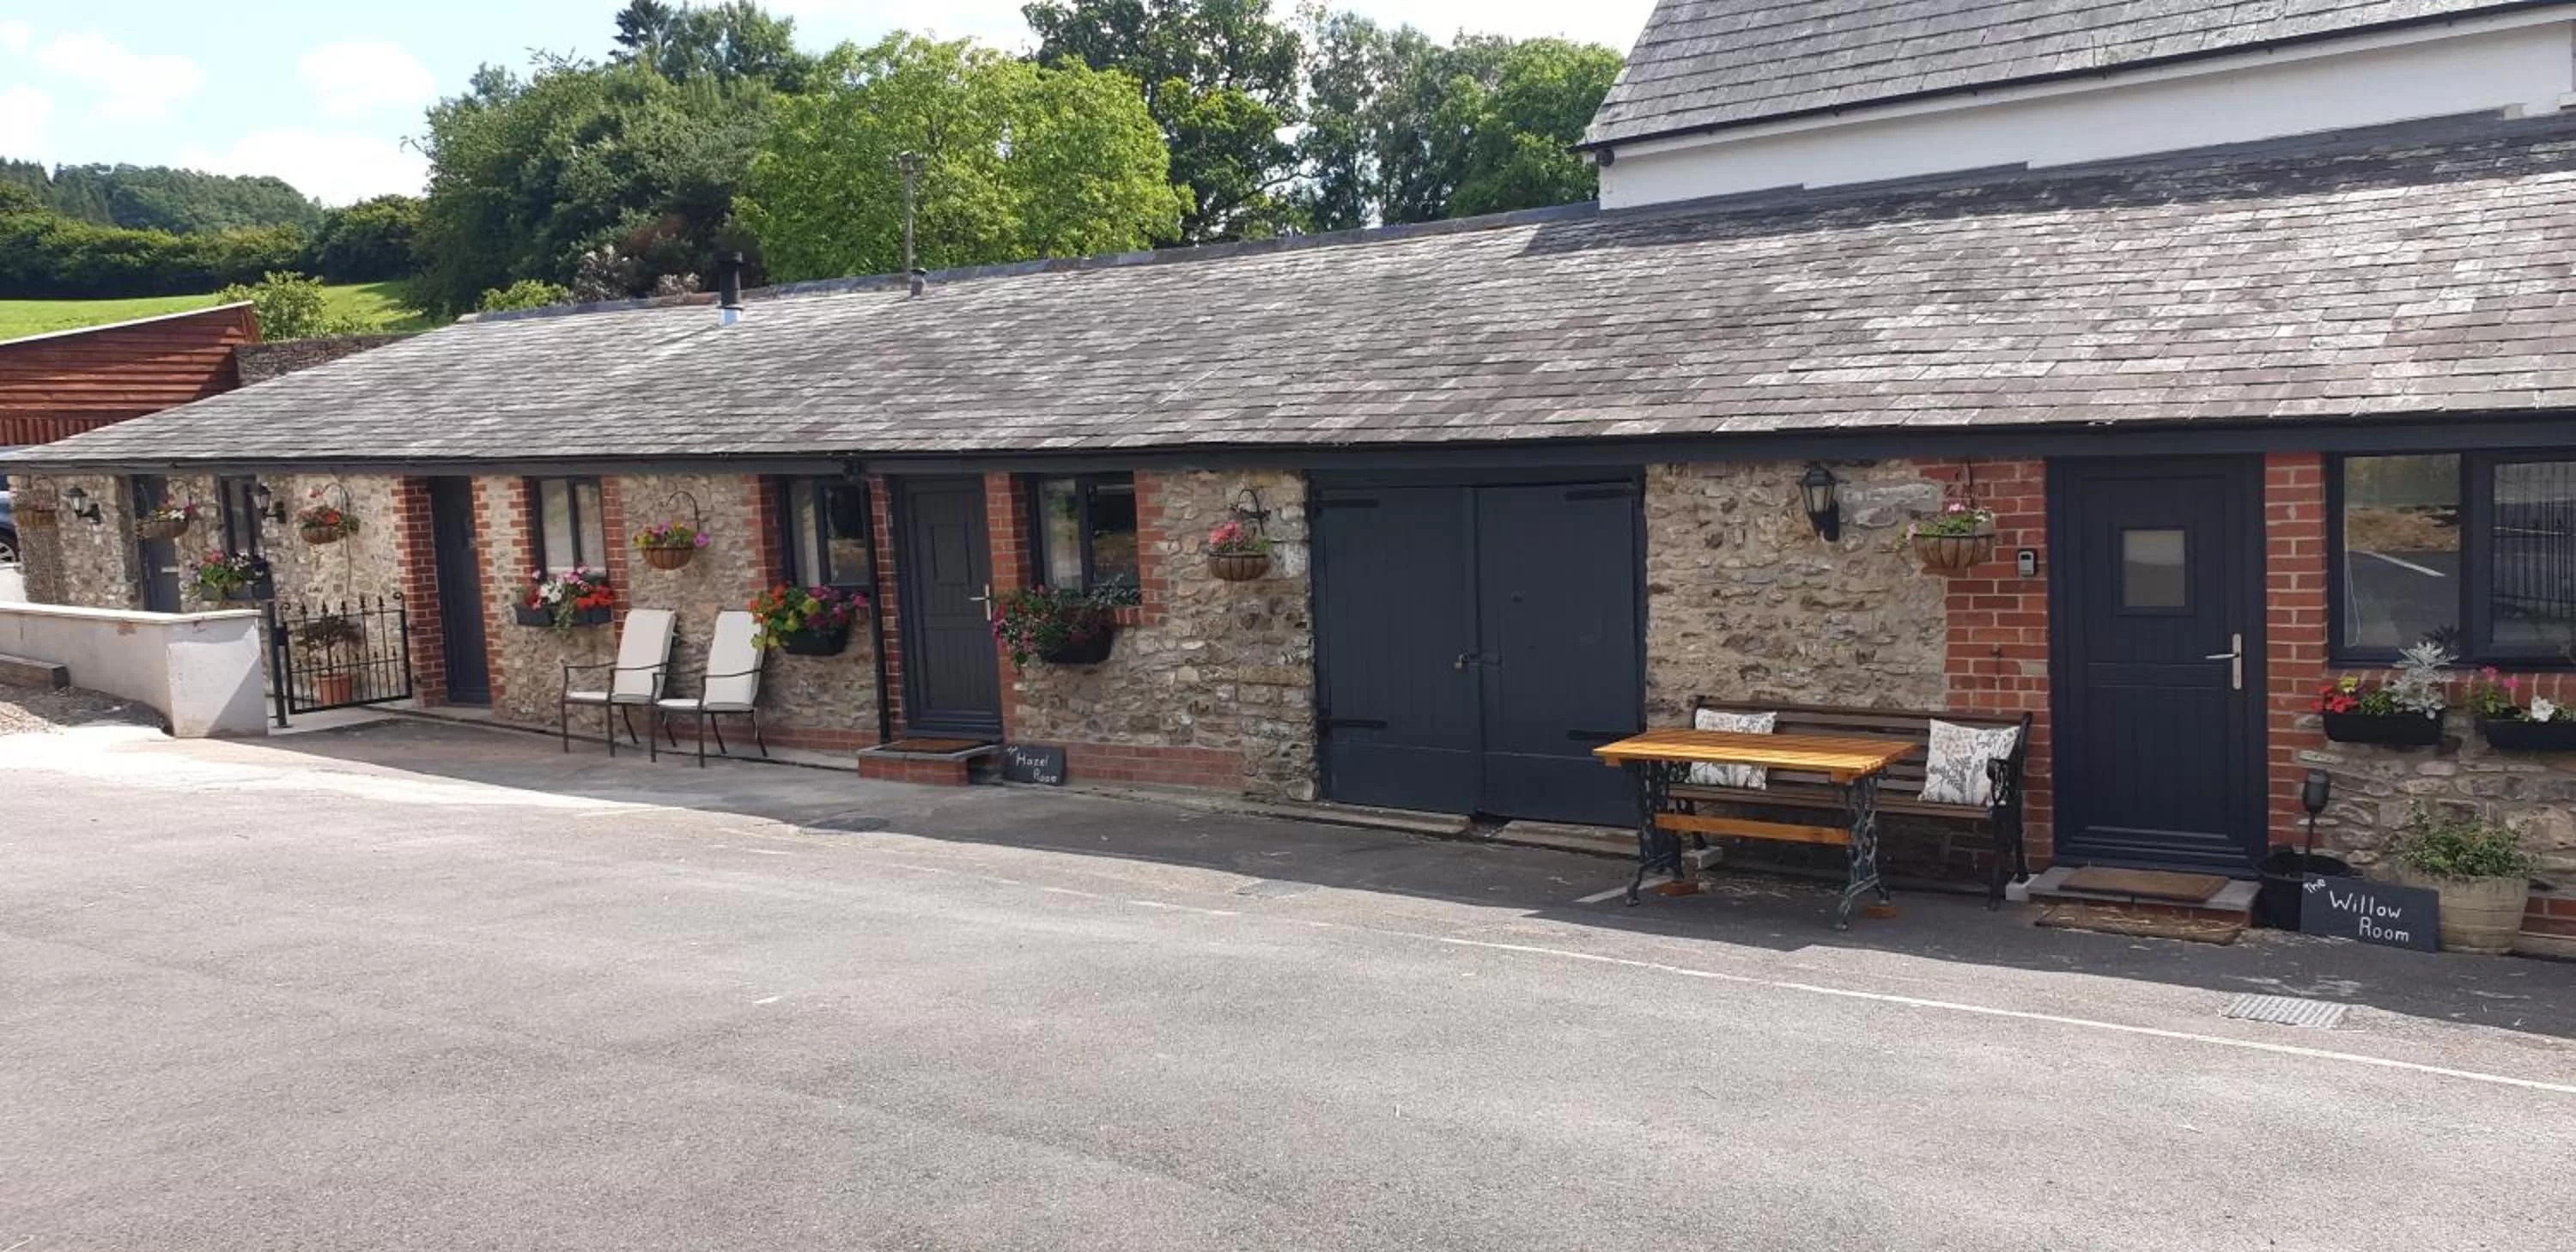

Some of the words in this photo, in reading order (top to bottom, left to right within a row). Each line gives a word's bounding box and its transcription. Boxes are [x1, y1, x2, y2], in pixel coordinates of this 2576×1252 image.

[2303, 878, 2326, 894] The
[2330, 890, 2402, 919] Willow
[2359, 916, 2409, 942] Room
